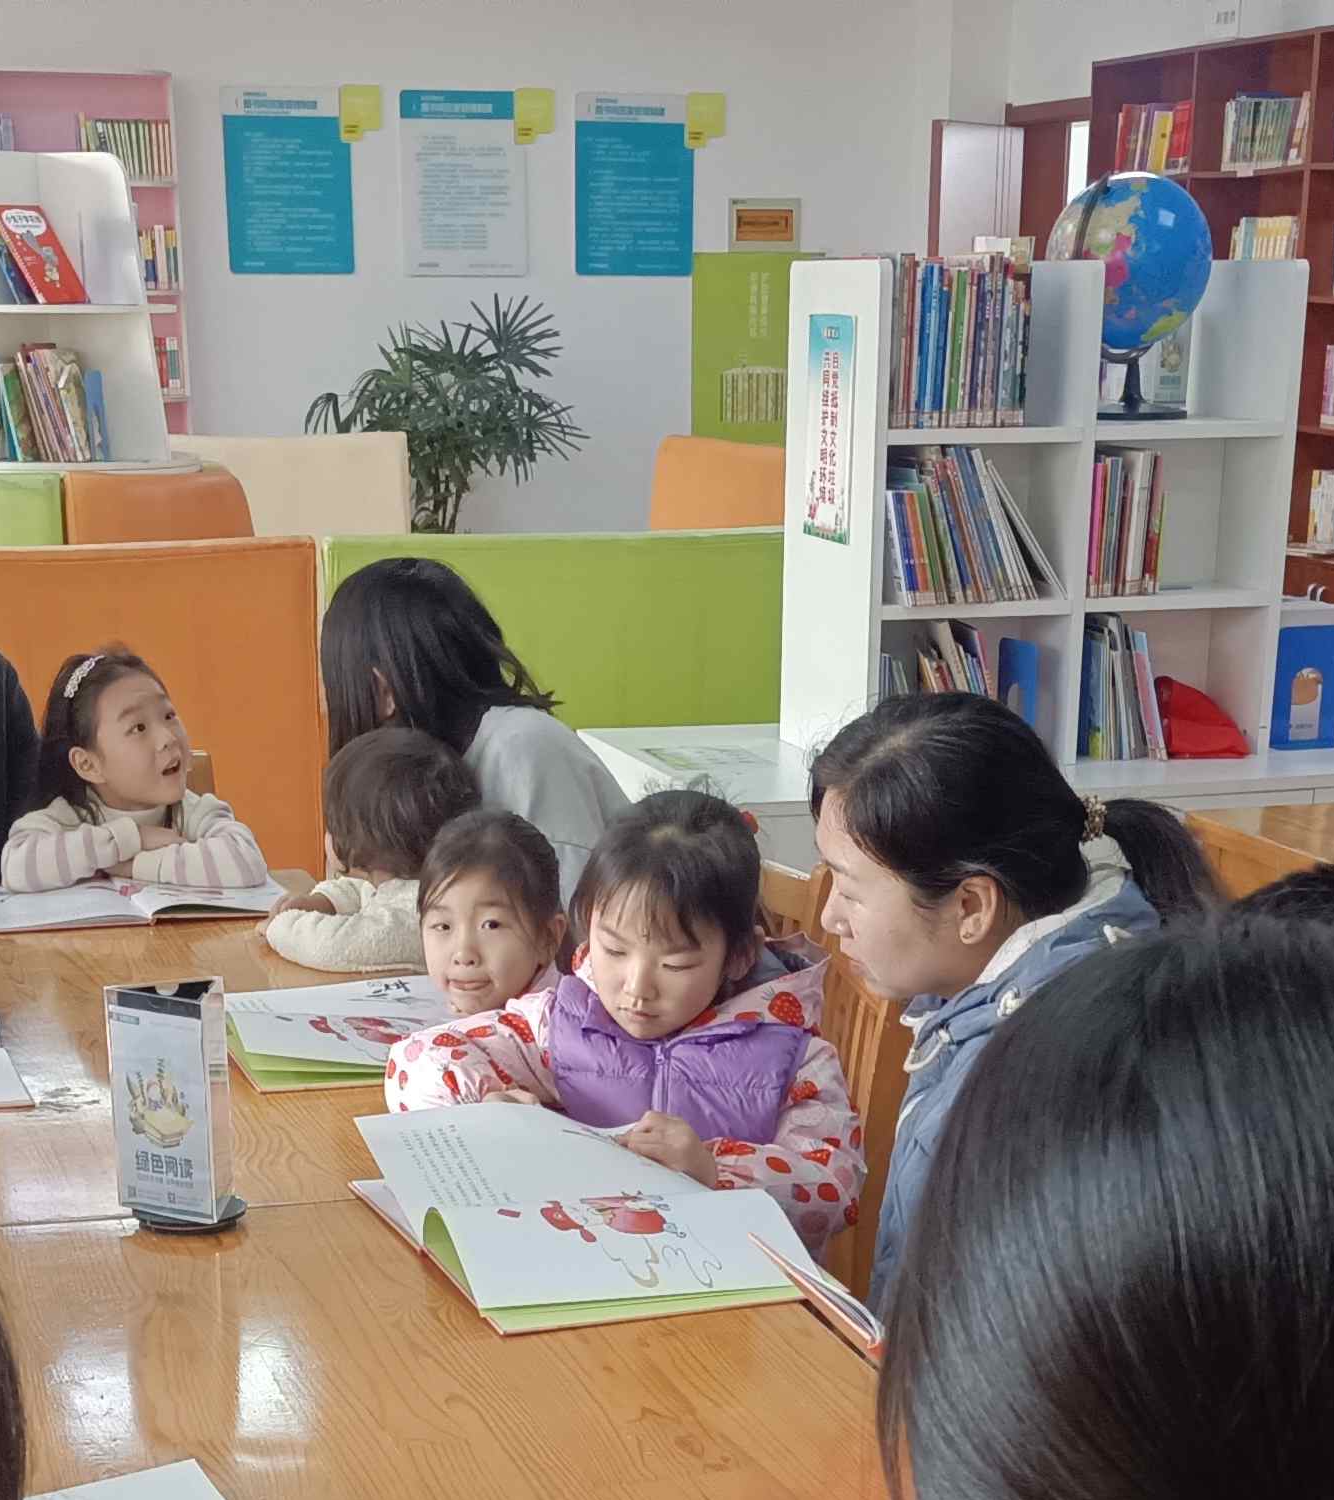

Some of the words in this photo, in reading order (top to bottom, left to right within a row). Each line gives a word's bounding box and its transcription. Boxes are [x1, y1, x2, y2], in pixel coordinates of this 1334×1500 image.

[818, 352, 830, 503] 共同维护文明环境
[826, 352, 839, 504] 自觉抵制文化垃圾
[135, 1151, 195, 1181] 绿色阅读
